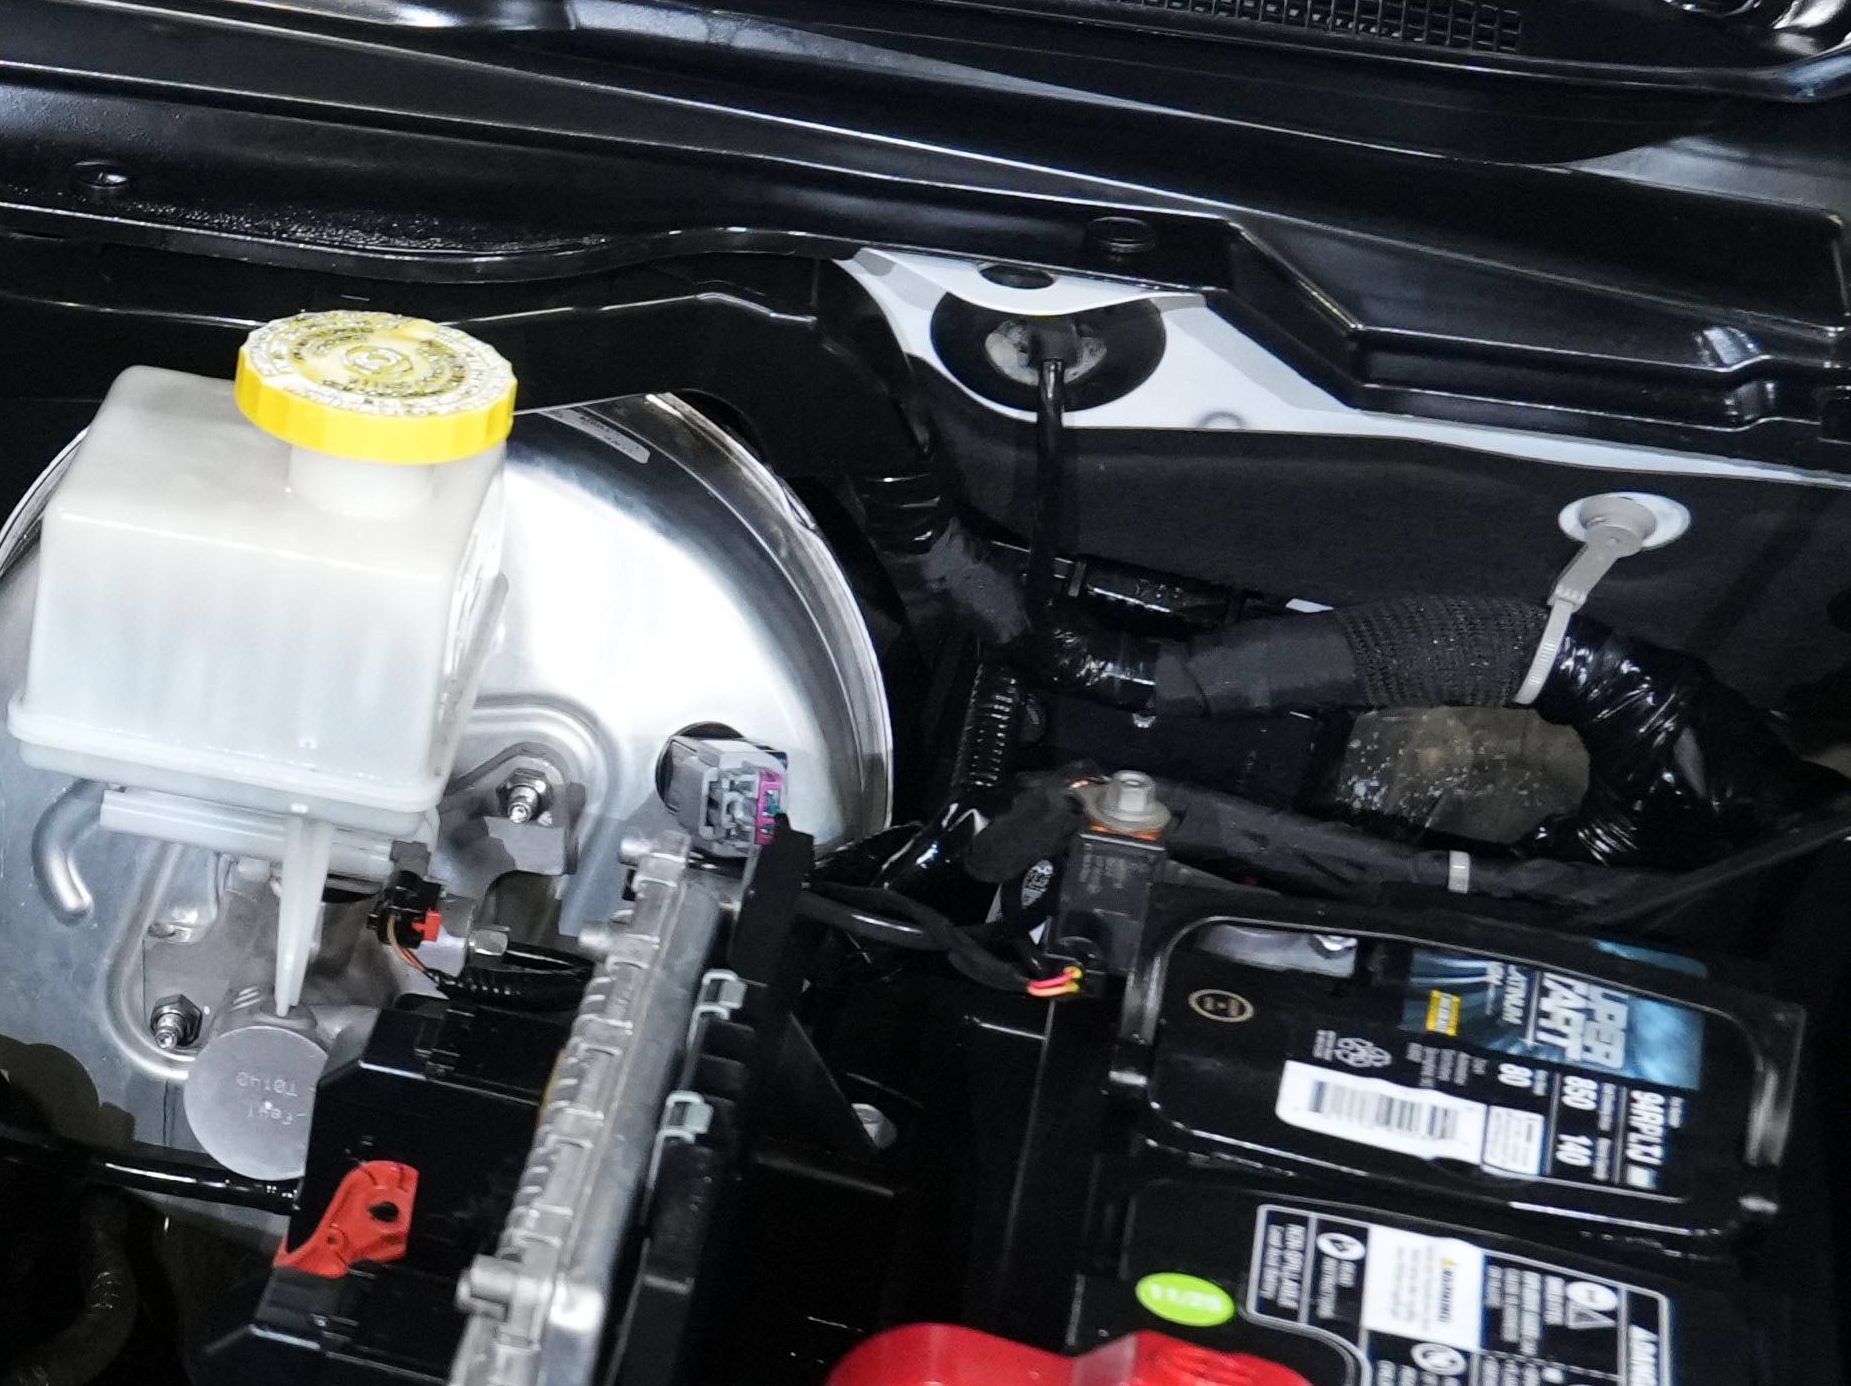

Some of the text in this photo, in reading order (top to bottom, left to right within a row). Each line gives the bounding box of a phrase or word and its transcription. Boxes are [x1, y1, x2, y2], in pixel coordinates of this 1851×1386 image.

[1535, 972, 1589, 1061] TART
[1581, 986, 1629, 1070] UPER
[1497, 1063, 1532, 1088] 80
[1554, 1075, 1598, 1167] 850 140
[1627, 1090, 1666, 1163] 94RPLTJ
